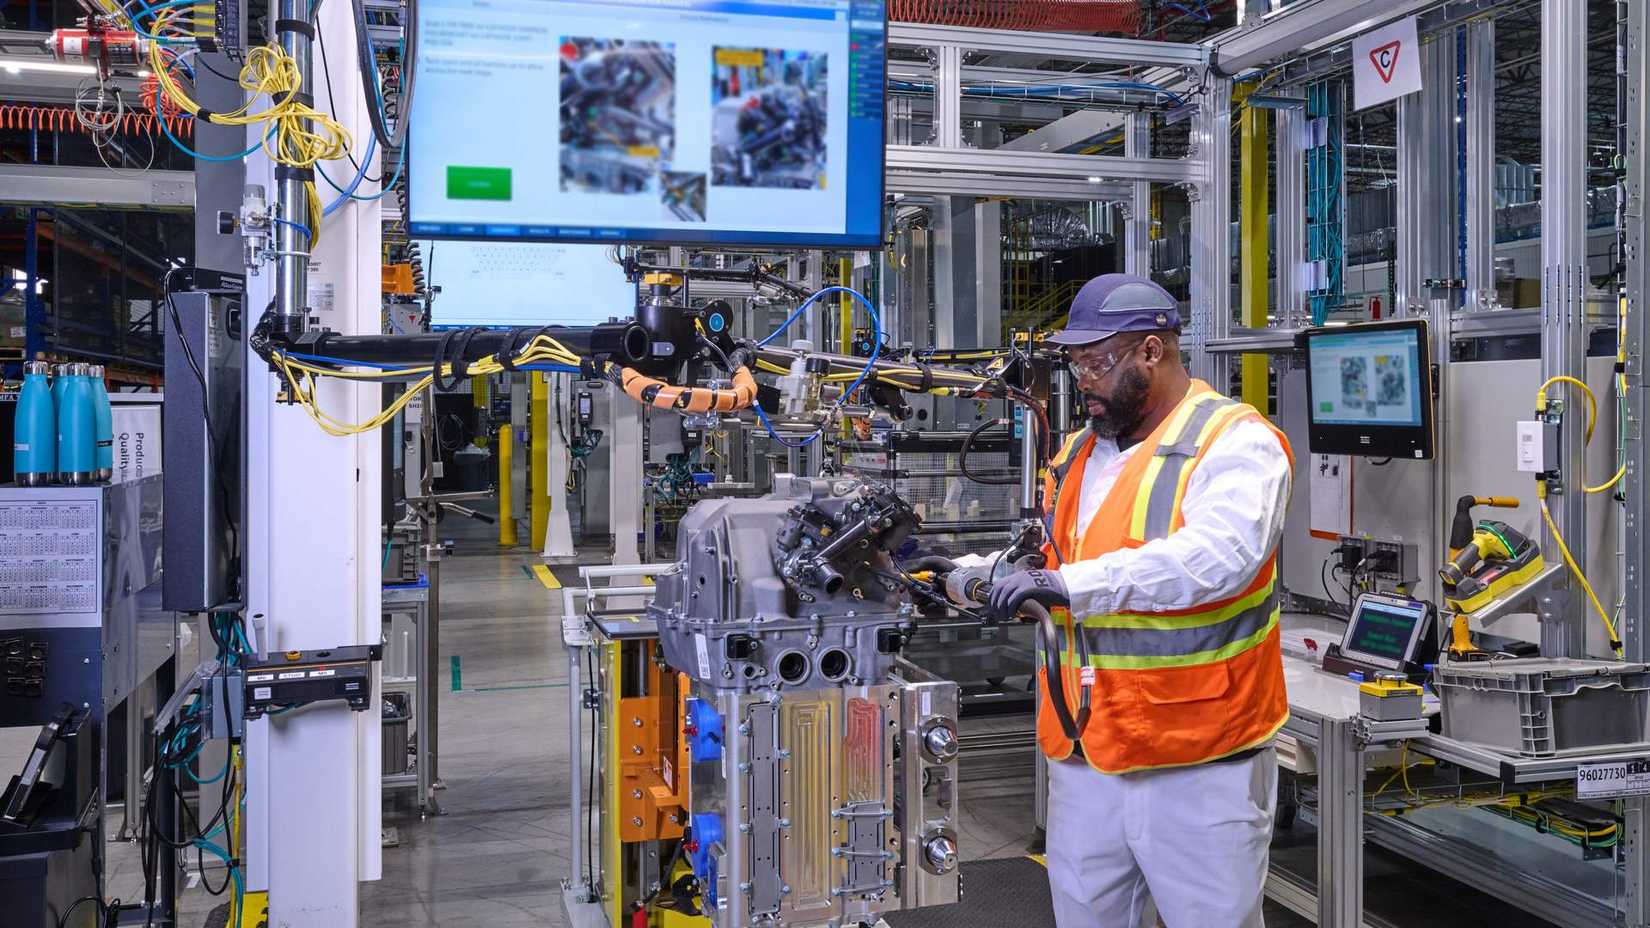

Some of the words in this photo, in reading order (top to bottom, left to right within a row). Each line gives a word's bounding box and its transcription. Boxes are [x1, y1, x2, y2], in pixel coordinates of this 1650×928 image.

[1380, 50, 1391, 68] C
[118, 432, 130, 470] Quality
[135, 432, 145, 471] Produc
[1579, 767, 1626, 781] 96027730
